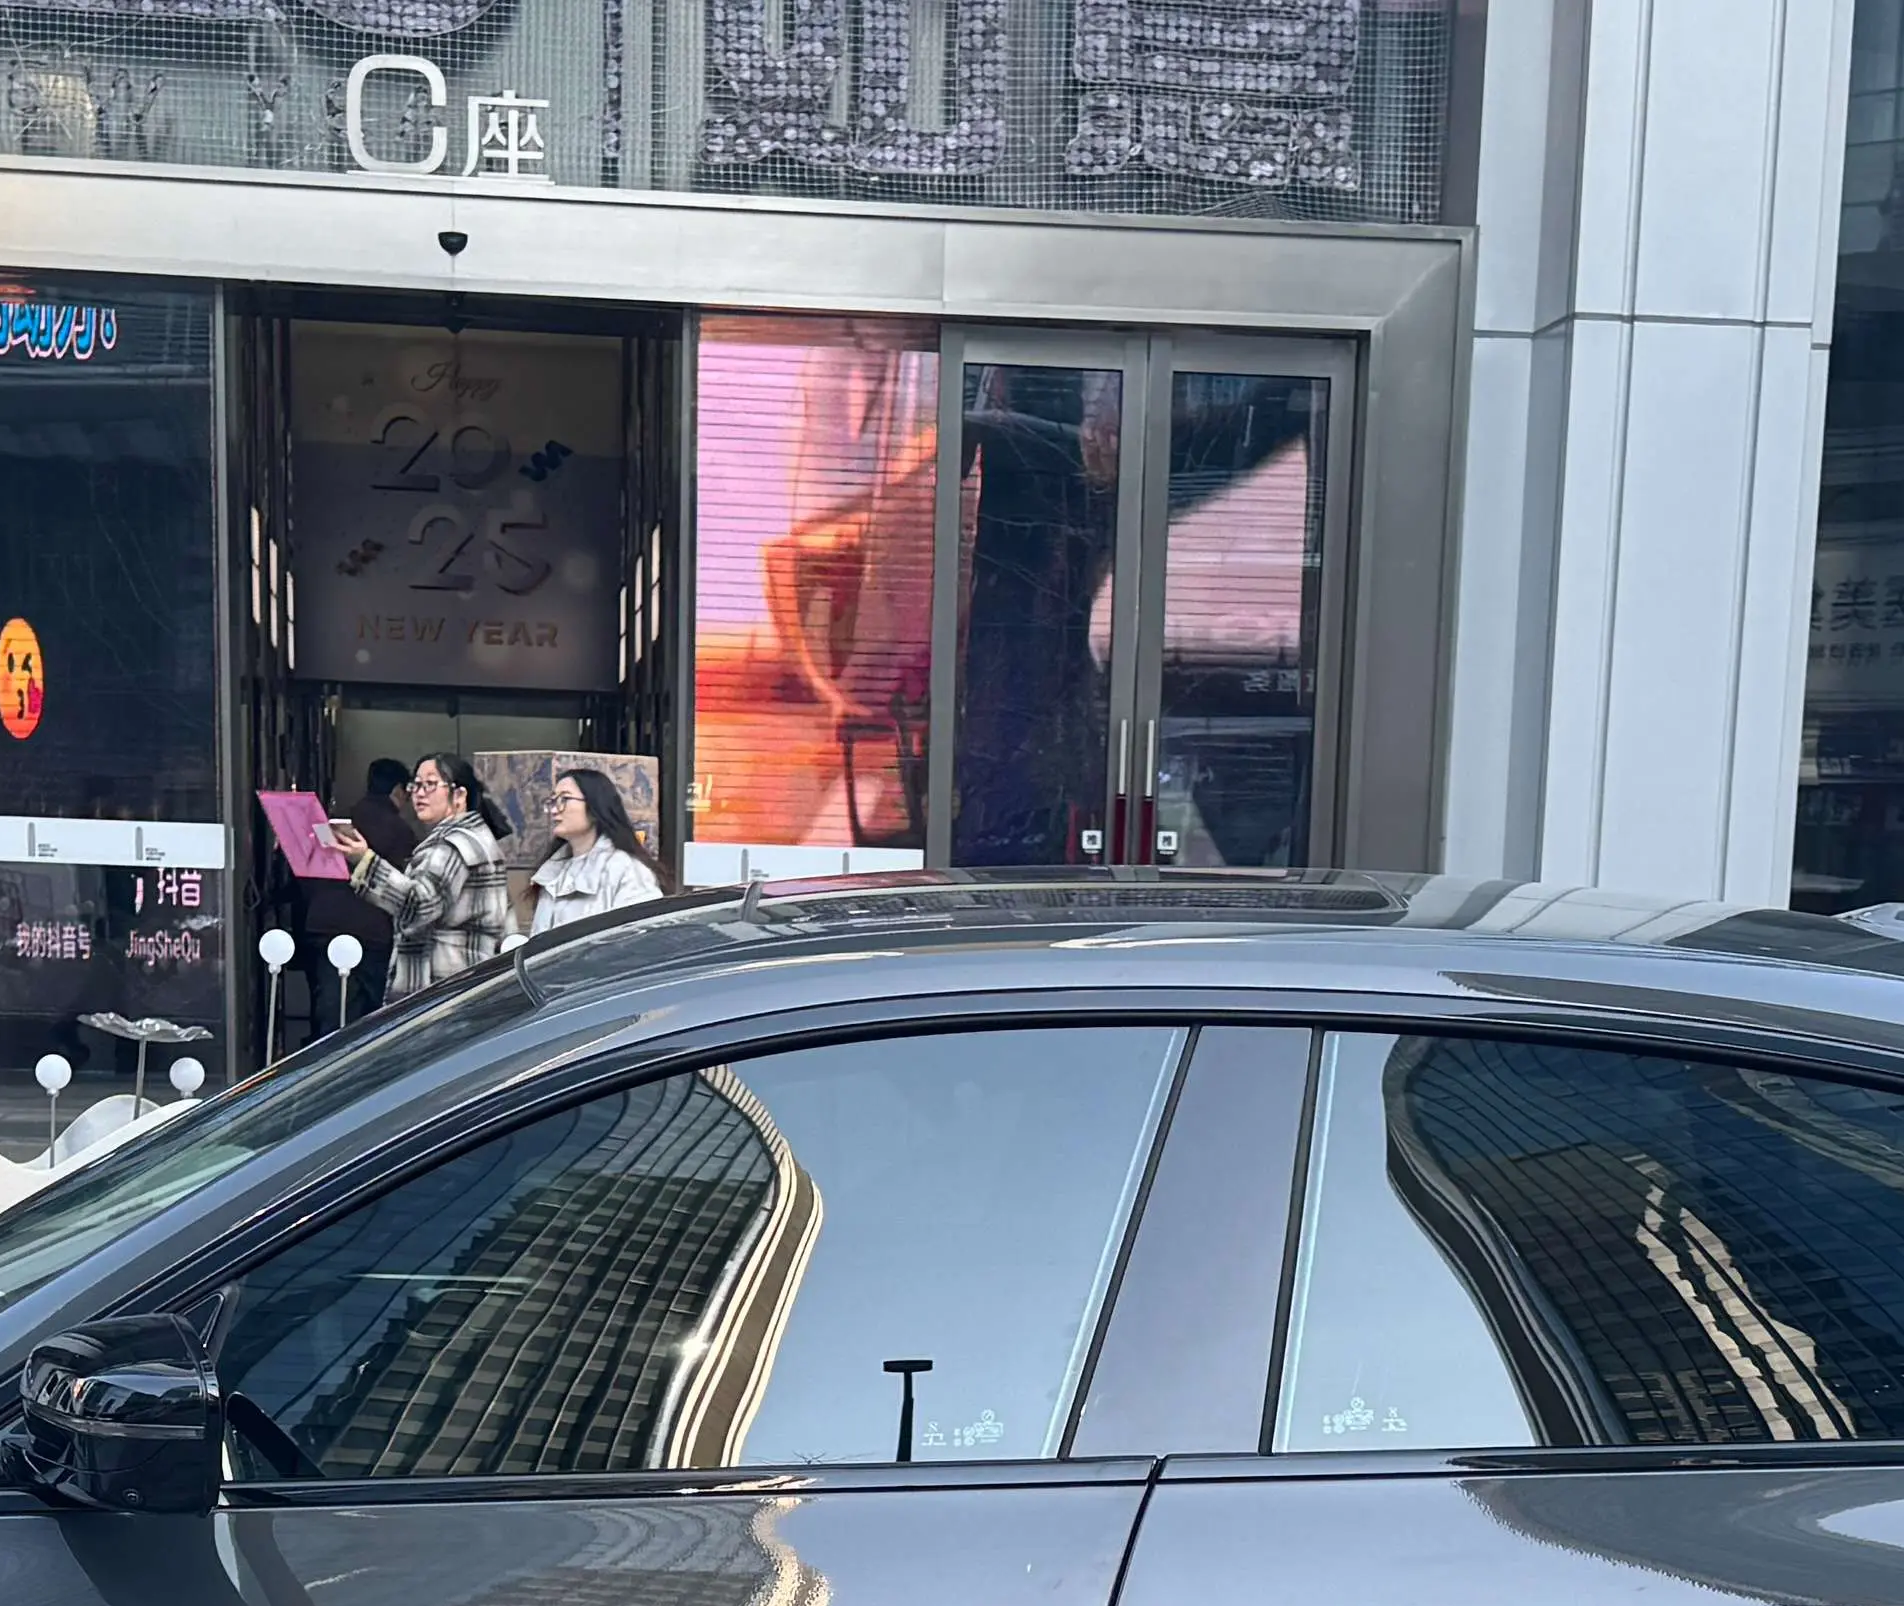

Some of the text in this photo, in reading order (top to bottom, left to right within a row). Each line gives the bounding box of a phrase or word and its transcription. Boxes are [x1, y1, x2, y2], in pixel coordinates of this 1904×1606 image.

[346, 54, 552, 178] C座
[410, 360, 506, 399] Happy
[369, 401, 513, 493] 20
[406, 496, 553, 597] 25
[354, 613, 560, 649] NEW YEAR
[156, 867, 203, 908] 抖音
[15, 920, 92, 960] 我的抖音号
